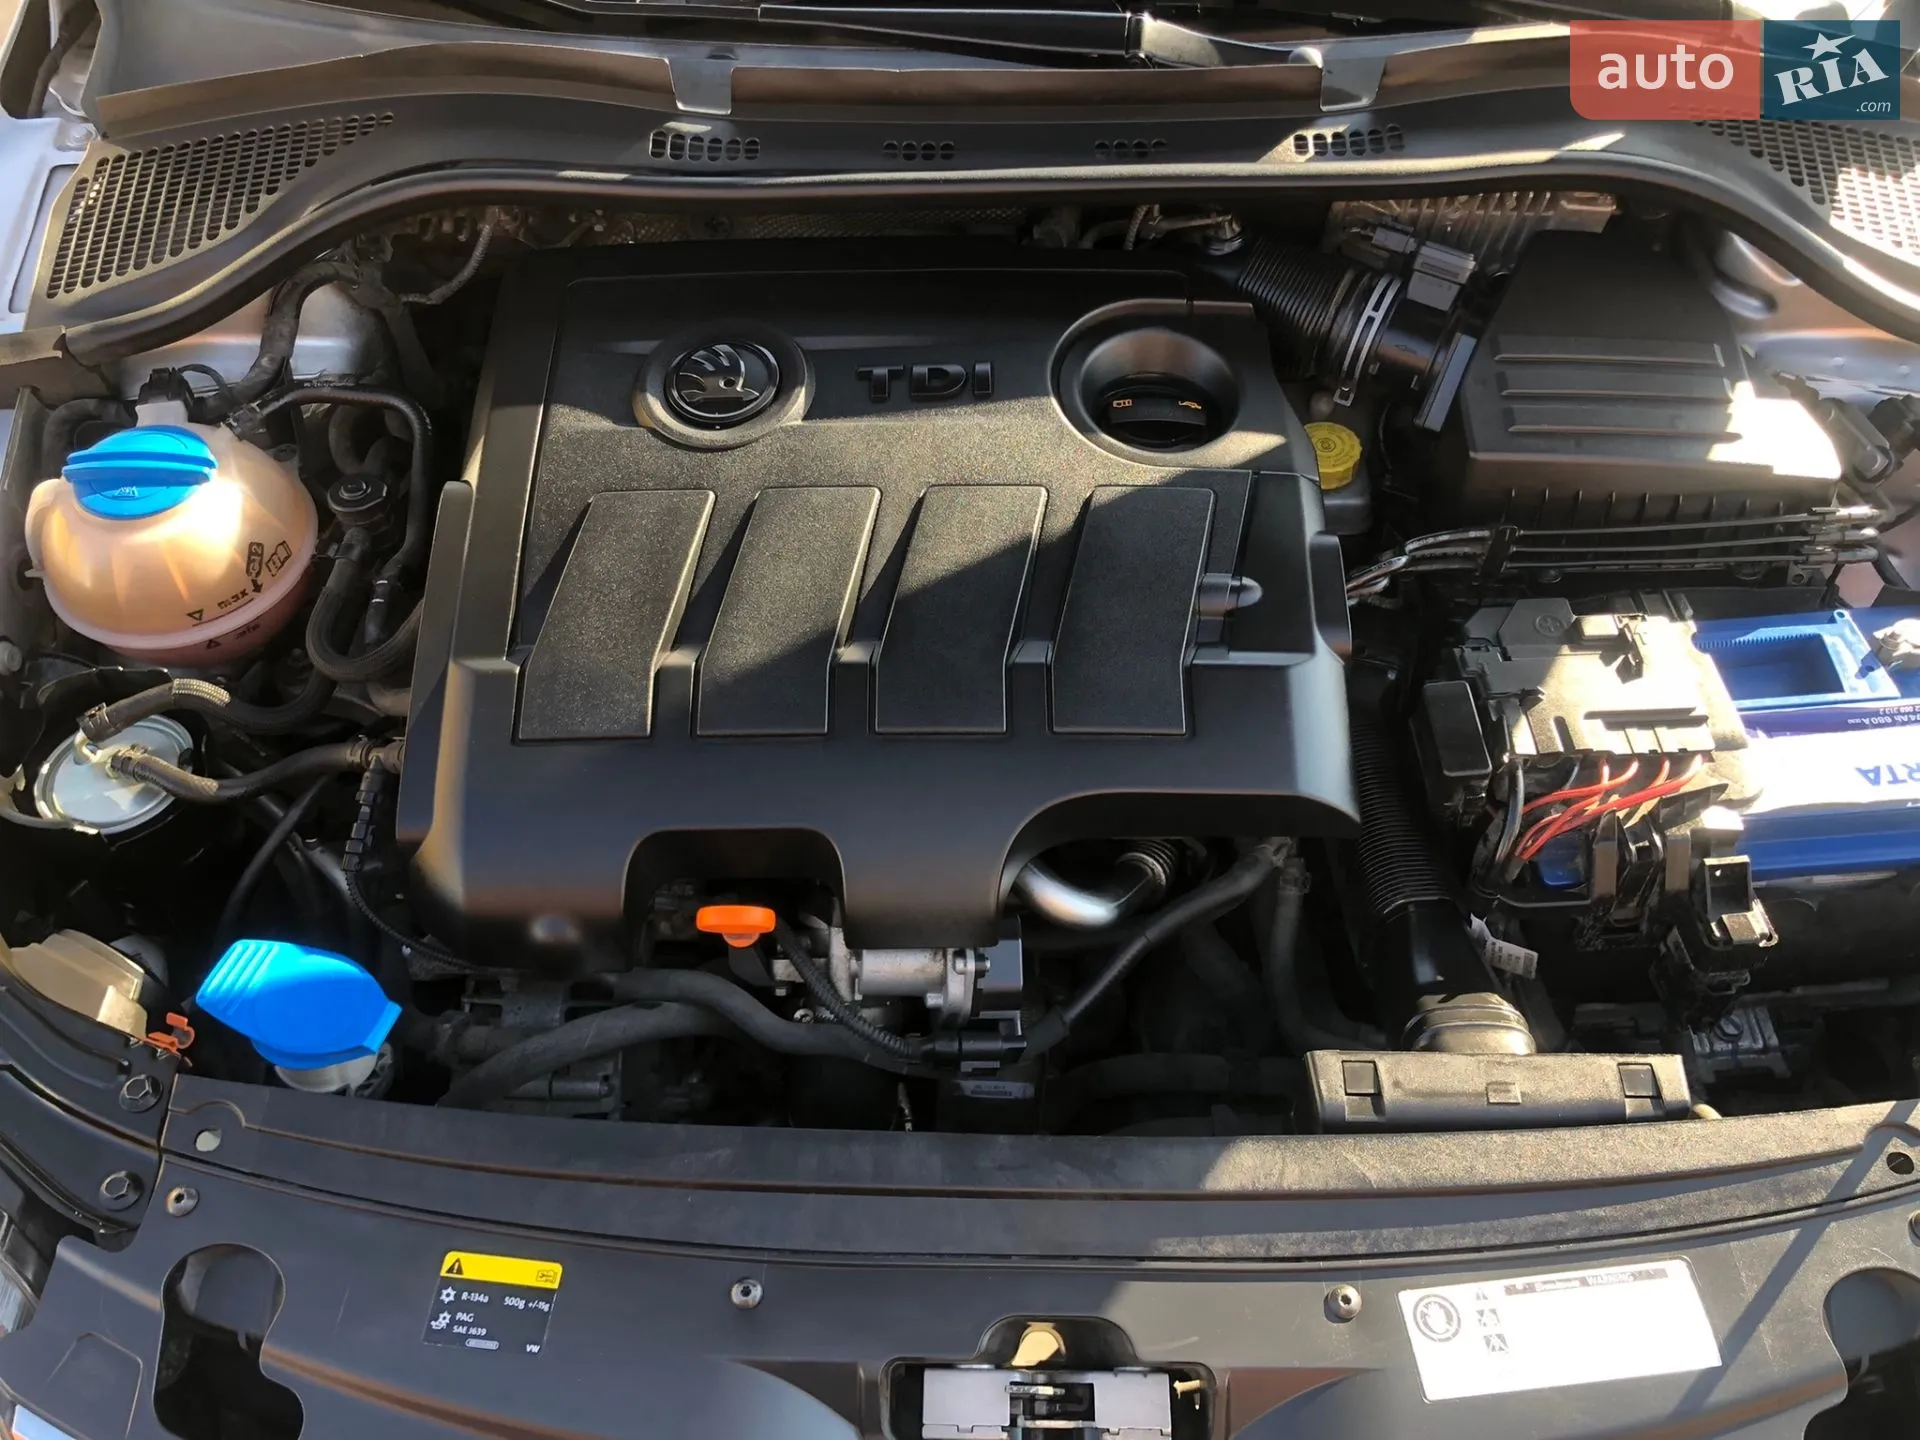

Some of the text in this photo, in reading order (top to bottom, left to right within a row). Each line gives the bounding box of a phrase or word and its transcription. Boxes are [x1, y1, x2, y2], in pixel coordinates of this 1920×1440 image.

[857, 361, 994, 400] TDI
[217, 588, 249, 610] max
[1585, 1271, 1634, 1286] WARNING
[461, 1291, 489, 1303] R-134a
[503, 1296, 525, 1309] 500g
[455, 1312, 475, 1322] PAG
[452, 1325, 487, 1336] SAE J639
[526, 1343, 541, 1353] VW
